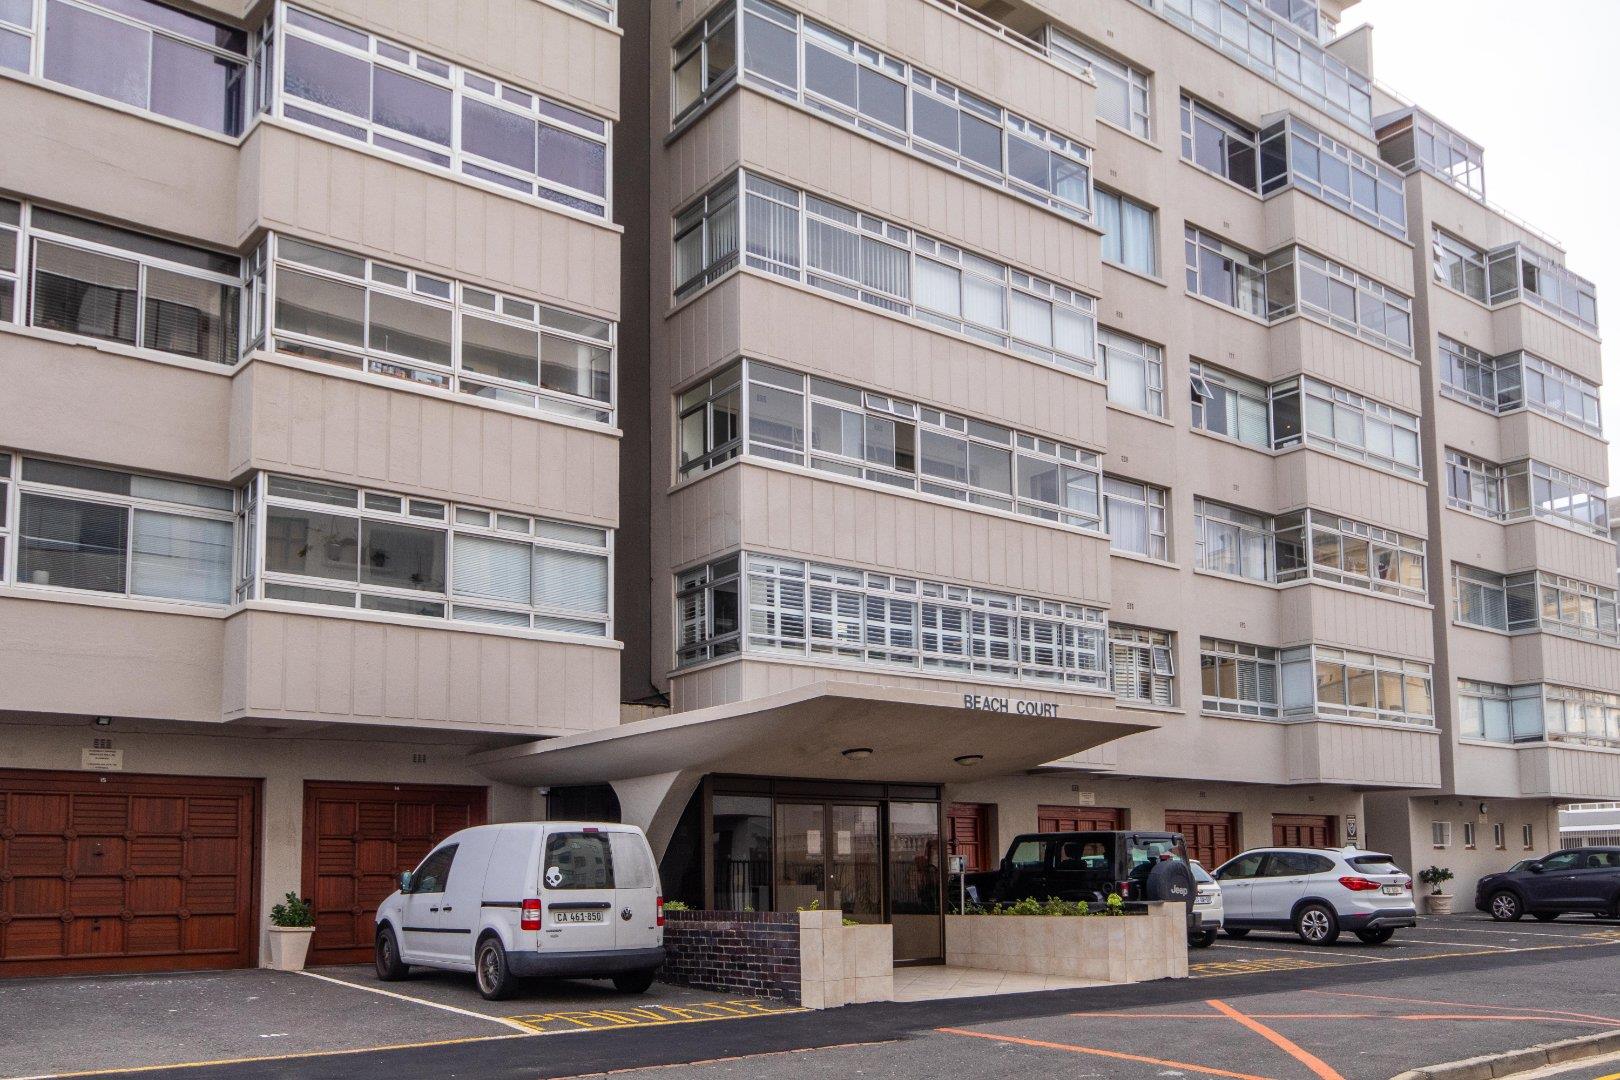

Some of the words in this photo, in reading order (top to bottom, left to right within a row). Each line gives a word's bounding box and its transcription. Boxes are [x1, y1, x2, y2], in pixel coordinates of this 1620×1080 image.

[963, 694, 1009, 713] BEACH
[1016, 700, 1060, 718] COURT
[1170, 884, 1188, 897] Jeep
[557, 912, 568, 922] CA
[570, 911, 601, 922] 461-850
[507, 999, 806, 1033] PRIVATE
